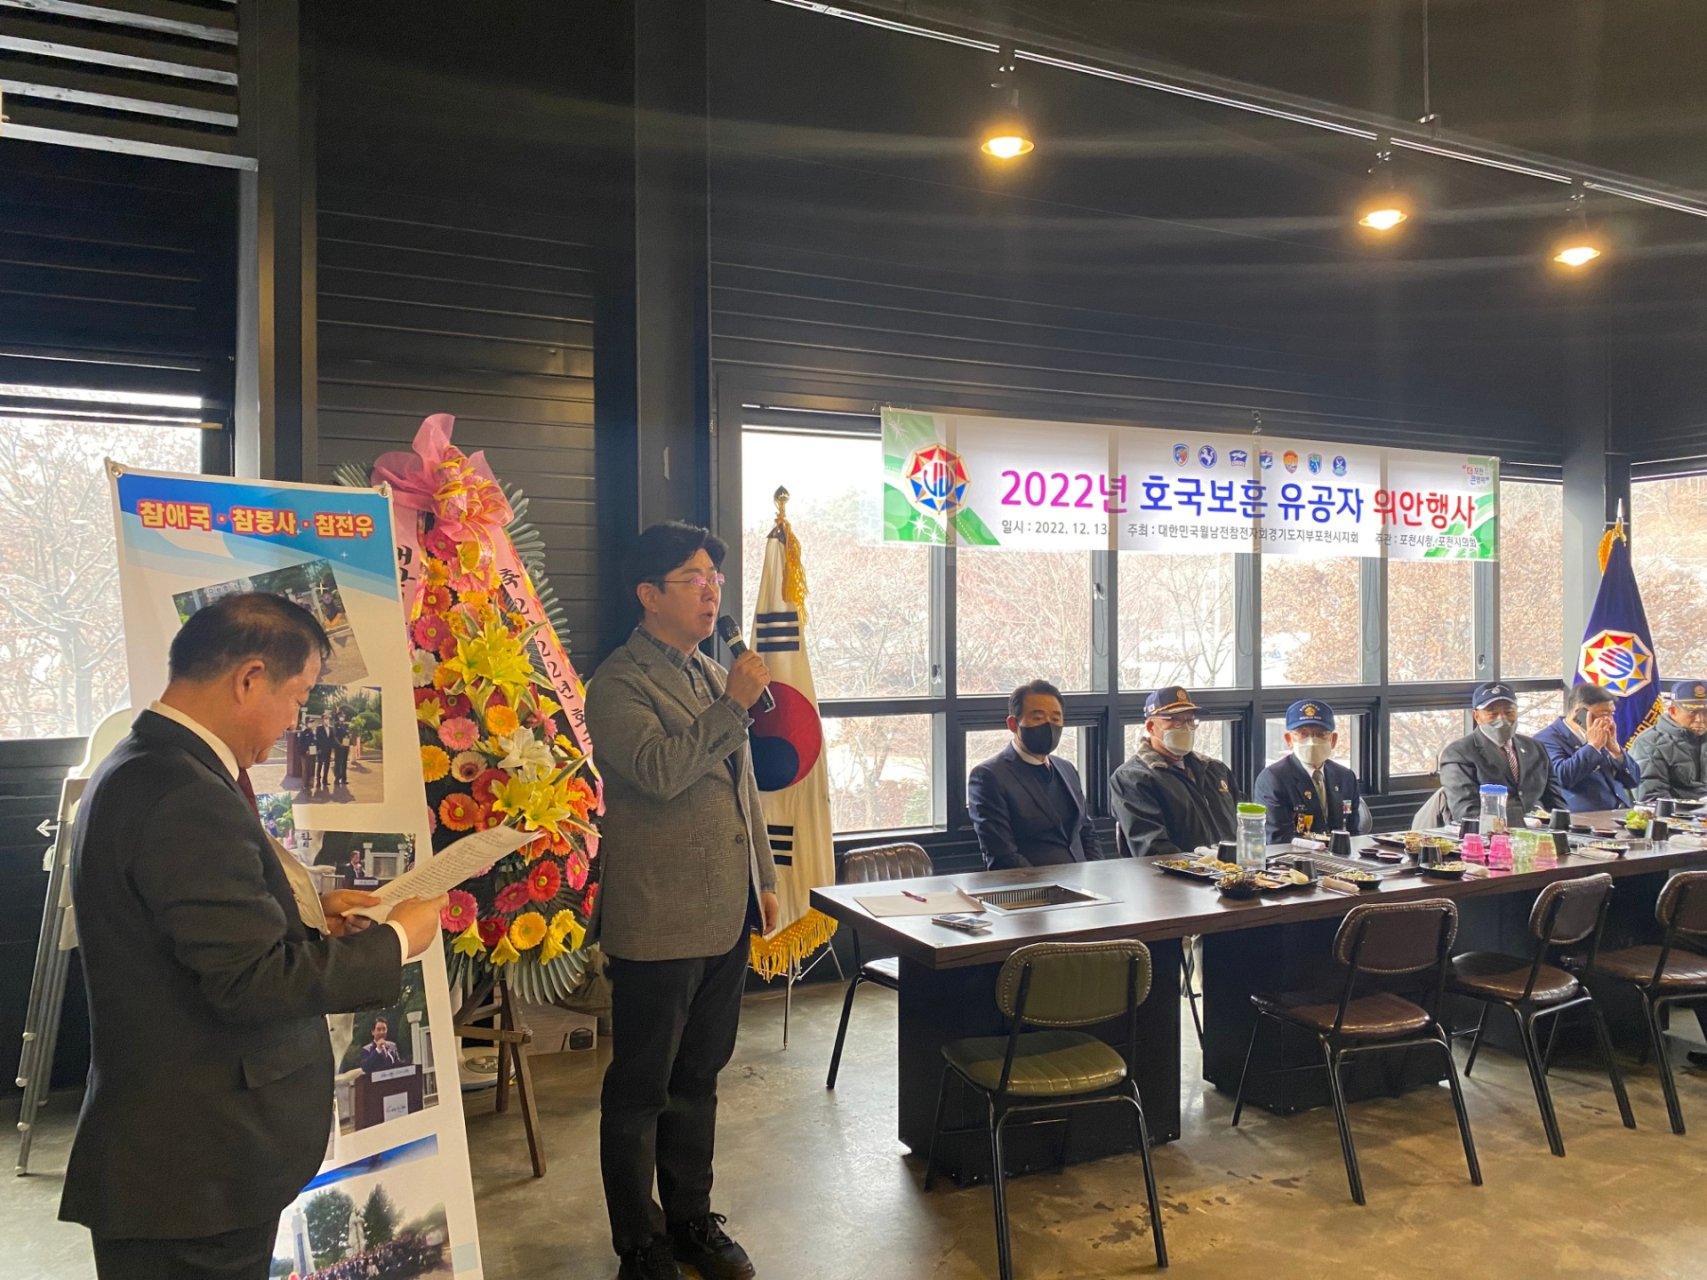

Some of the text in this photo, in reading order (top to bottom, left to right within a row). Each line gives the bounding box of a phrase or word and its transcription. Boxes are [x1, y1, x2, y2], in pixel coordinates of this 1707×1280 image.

[1000, 470, 1476, 530] 2022년 호국보훈 유공자 위안행사
[138, 500, 211, 531] 참애국
[231, 506, 296, 535] 참봉사
[314, 512, 374, 539] 참전우
[1001, 520, 1024, 535] 일시
[1127, 523, 1149, 537] 주최
